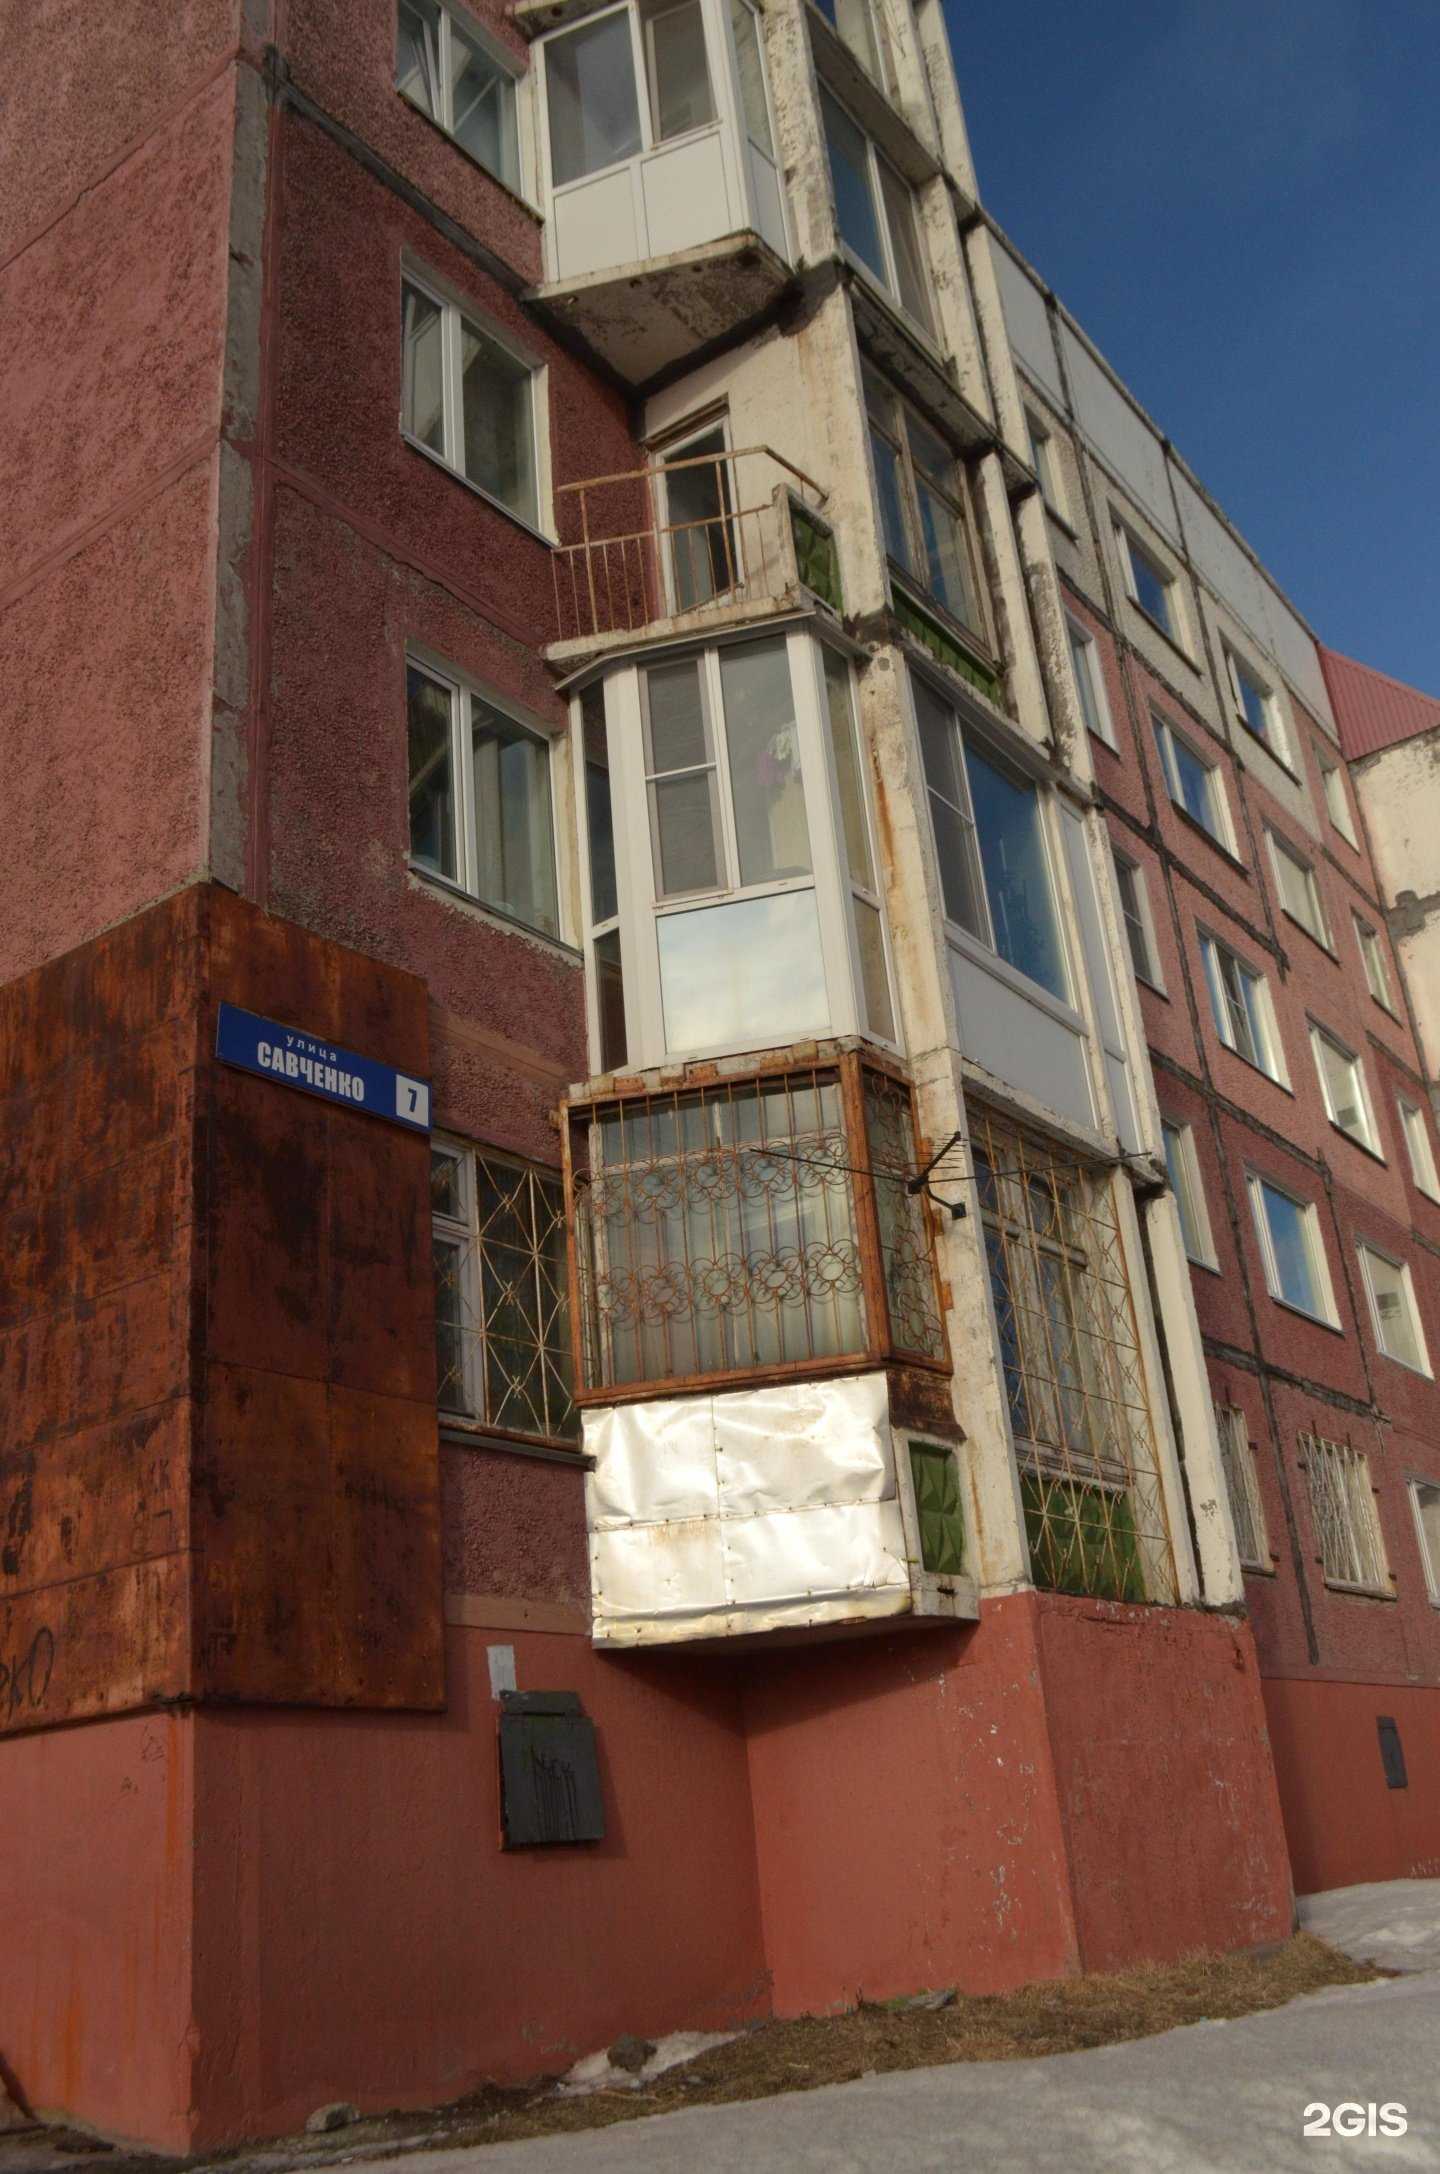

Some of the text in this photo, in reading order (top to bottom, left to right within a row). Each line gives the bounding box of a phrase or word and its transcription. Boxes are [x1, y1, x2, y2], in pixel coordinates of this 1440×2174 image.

[286, 1034, 337, 1061] улица
[257, 1041, 365, 1102] САВЧЕНКО
[407, 1087, 418, 1113] 7
